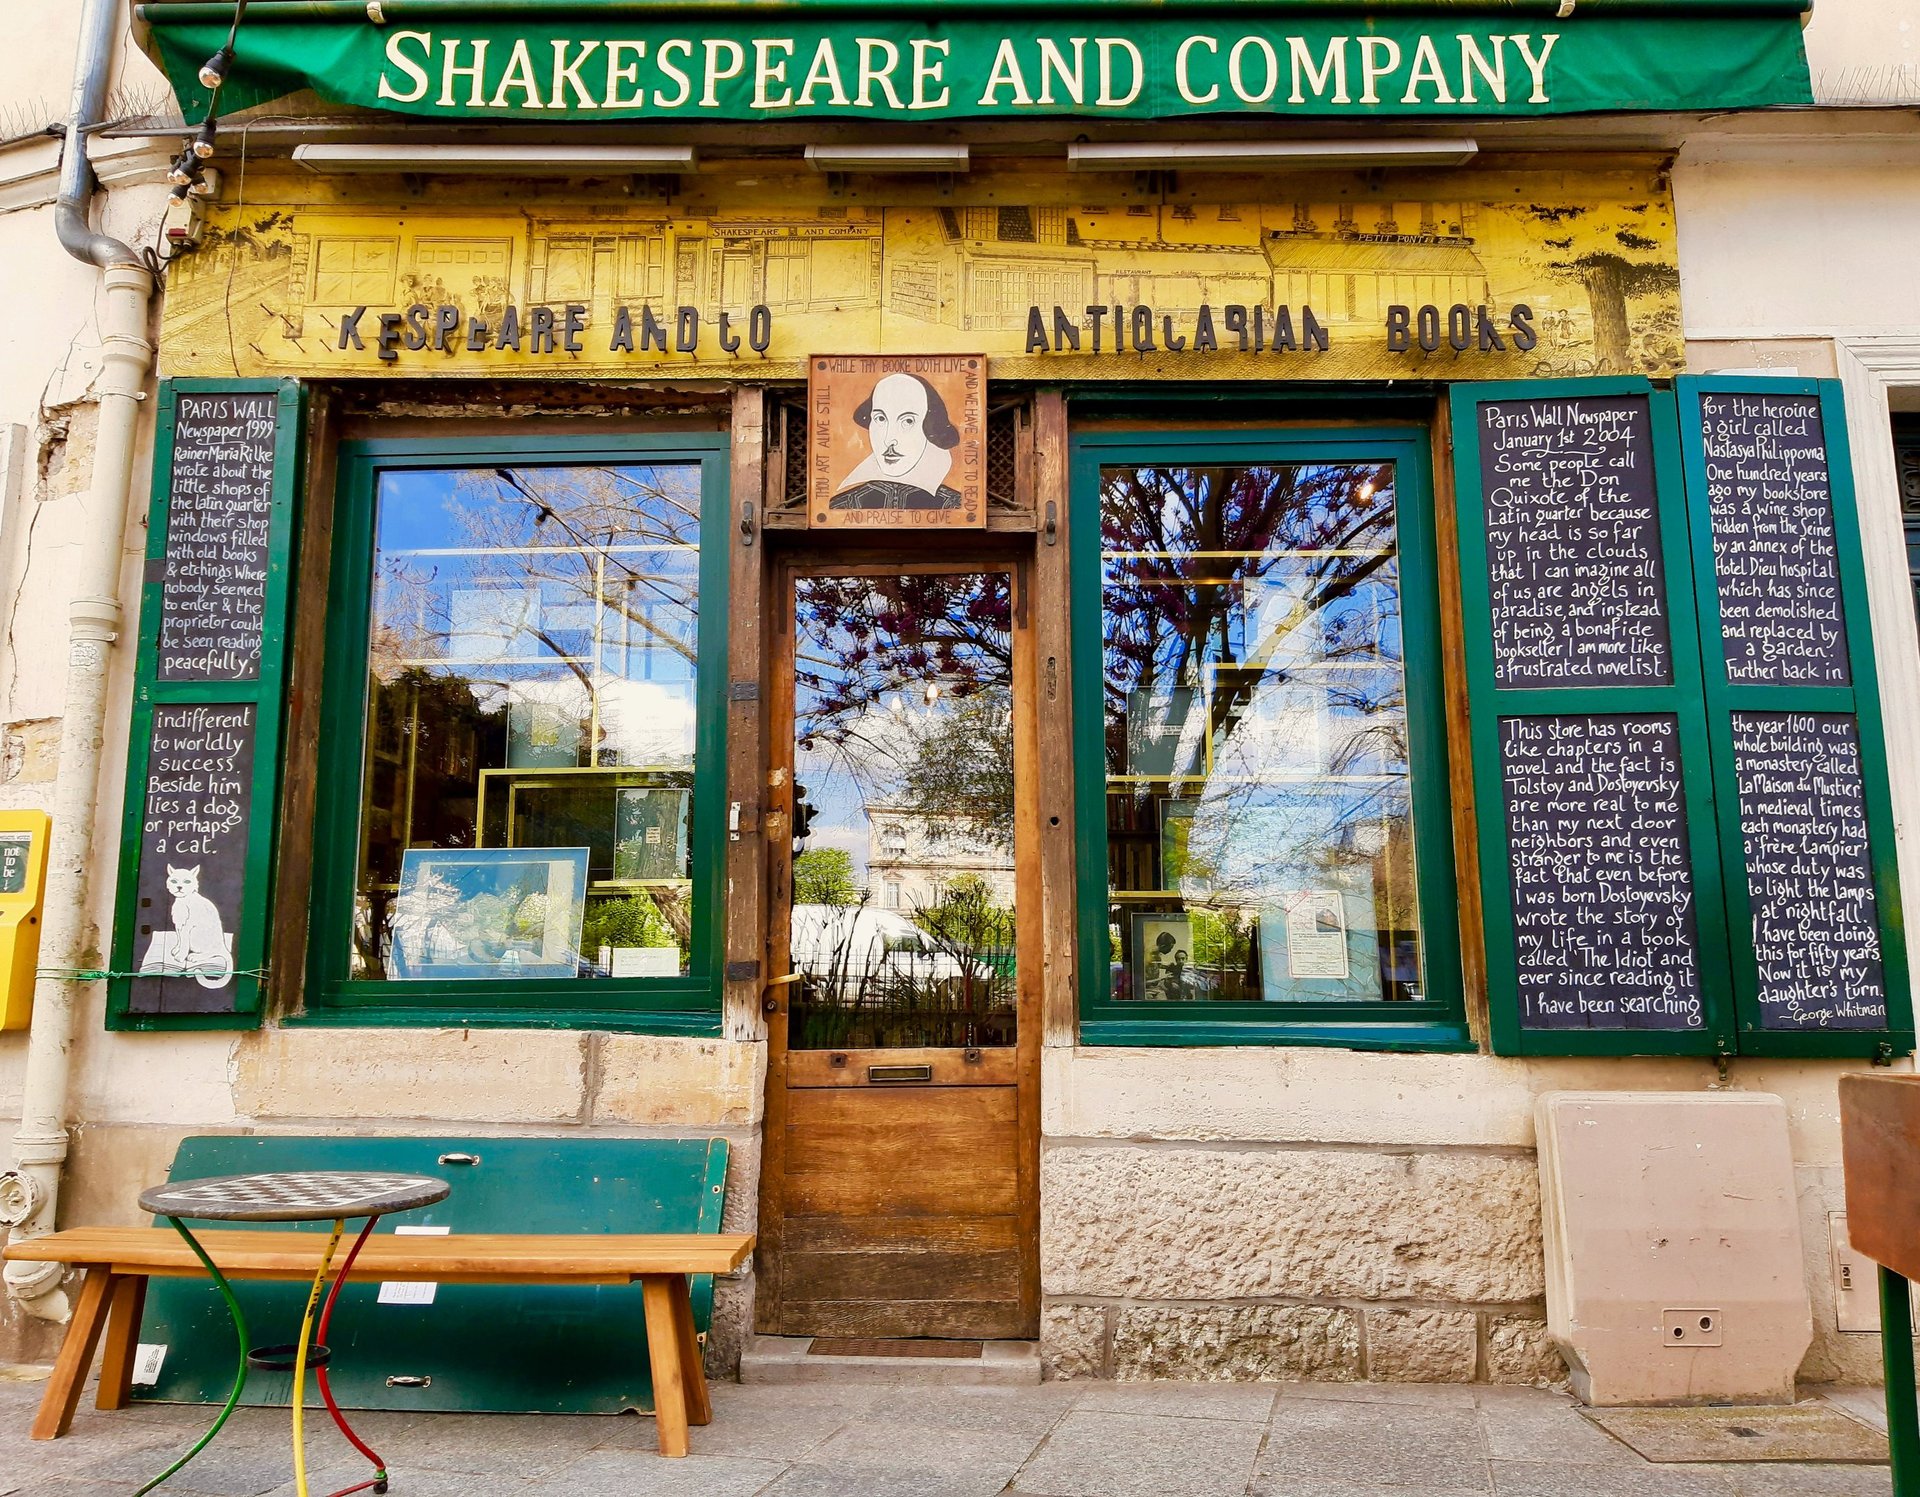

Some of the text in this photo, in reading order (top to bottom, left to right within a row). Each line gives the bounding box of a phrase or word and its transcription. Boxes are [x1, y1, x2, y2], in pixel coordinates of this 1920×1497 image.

[377, 30, 1560, 110] SHAKESPEARE AND COMPANY
[713, 228, 779, 237] SHAKESPEARE
[1359, 234, 1392, 243] PETIT
[1397, 235, 1423, 243] PONT
[610, 304, 698, 353] AND
[1387, 303, 1538, 353] BOOKS
[829, 358, 966, 373] WHILE THY BOOKE DOTH LIVE
[181, 399, 276, 419] PARIS WALL
[1485, 402, 1638, 433] Paris Wall Newspaper
[1702, 396, 1819, 419] for the heroine
[176, 420, 274, 442] Newspaper 1999
[964, 370, 979, 512] AND WE HAVE WITS TO READ
[1702, 418, 1809, 441] a girl called
[816, 385, 830, 500] THOU ART ALIVE STILL
[1493, 426, 1635, 458] January 1st 2004
[1703, 435, 1754, 464] Nastasya
[174, 445, 274, 463] Rainer Maria Rilke
[1494, 451, 1635, 478] Some people call
[173, 462, 273, 480] wrote about the
[1509, 469, 1620, 488] me the Don
[1706, 463, 1828, 489] One hundred years
[211, 480, 252, 499] shops
[253, 481, 272, 501] of
[1491, 487, 1632, 509] Quixote of the
[1708, 482, 1829, 503] ago my bookstore
[170, 495, 272, 518] the latin quarter
[843, 510, 952, 524] AND PRAISE TO GIVE
[1488, 503, 1652, 528] Latin quarter because
[170, 511, 269, 536] with their shop
[168, 529, 269, 552] windows filled
[166, 546, 257, 563] with old books
[166, 561, 178, 577] &
[235, 565, 267, 582] Where
[164, 580, 264, 601] nobody seemed
[164, 598, 262, 615] to enter & the
[163, 613, 263, 636] proprietor could
[162, 633, 263, 660] be seen reading
[164, 649, 254, 679] peacefully,
[1495, 656, 1668, 683] a frustrated novelist.
[157, 706, 250, 734] indifferent
[1503, 718, 1672, 741] This store has rooms
[1732, 714, 1850, 738] the year 1600 our
[153, 732, 244, 758] to worldly
[1504, 738, 1663, 762] like chapters in a
[158, 756, 241, 775] success.
[147, 774, 241, 796] Beside him
[1505, 773, 1680, 801] Tolstoy and Dostoyevsky
[147, 796, 243, 826] lies a dog
[145, 815, 230, 838] or perhaps
[4, 846, 20, 857] not
[156, 834, 218, 854] a cat.
[3, 865, 16, 878] be
[5, 857, 16, 866] to
[1515, 904, 1684, 932] wrote the story of
[1761, 900, 1868, 930] at nightfall.
[1757, 979, 1884, 1011] daughter's turn.
[1835, 1001, 1886, 1018] Whitman
